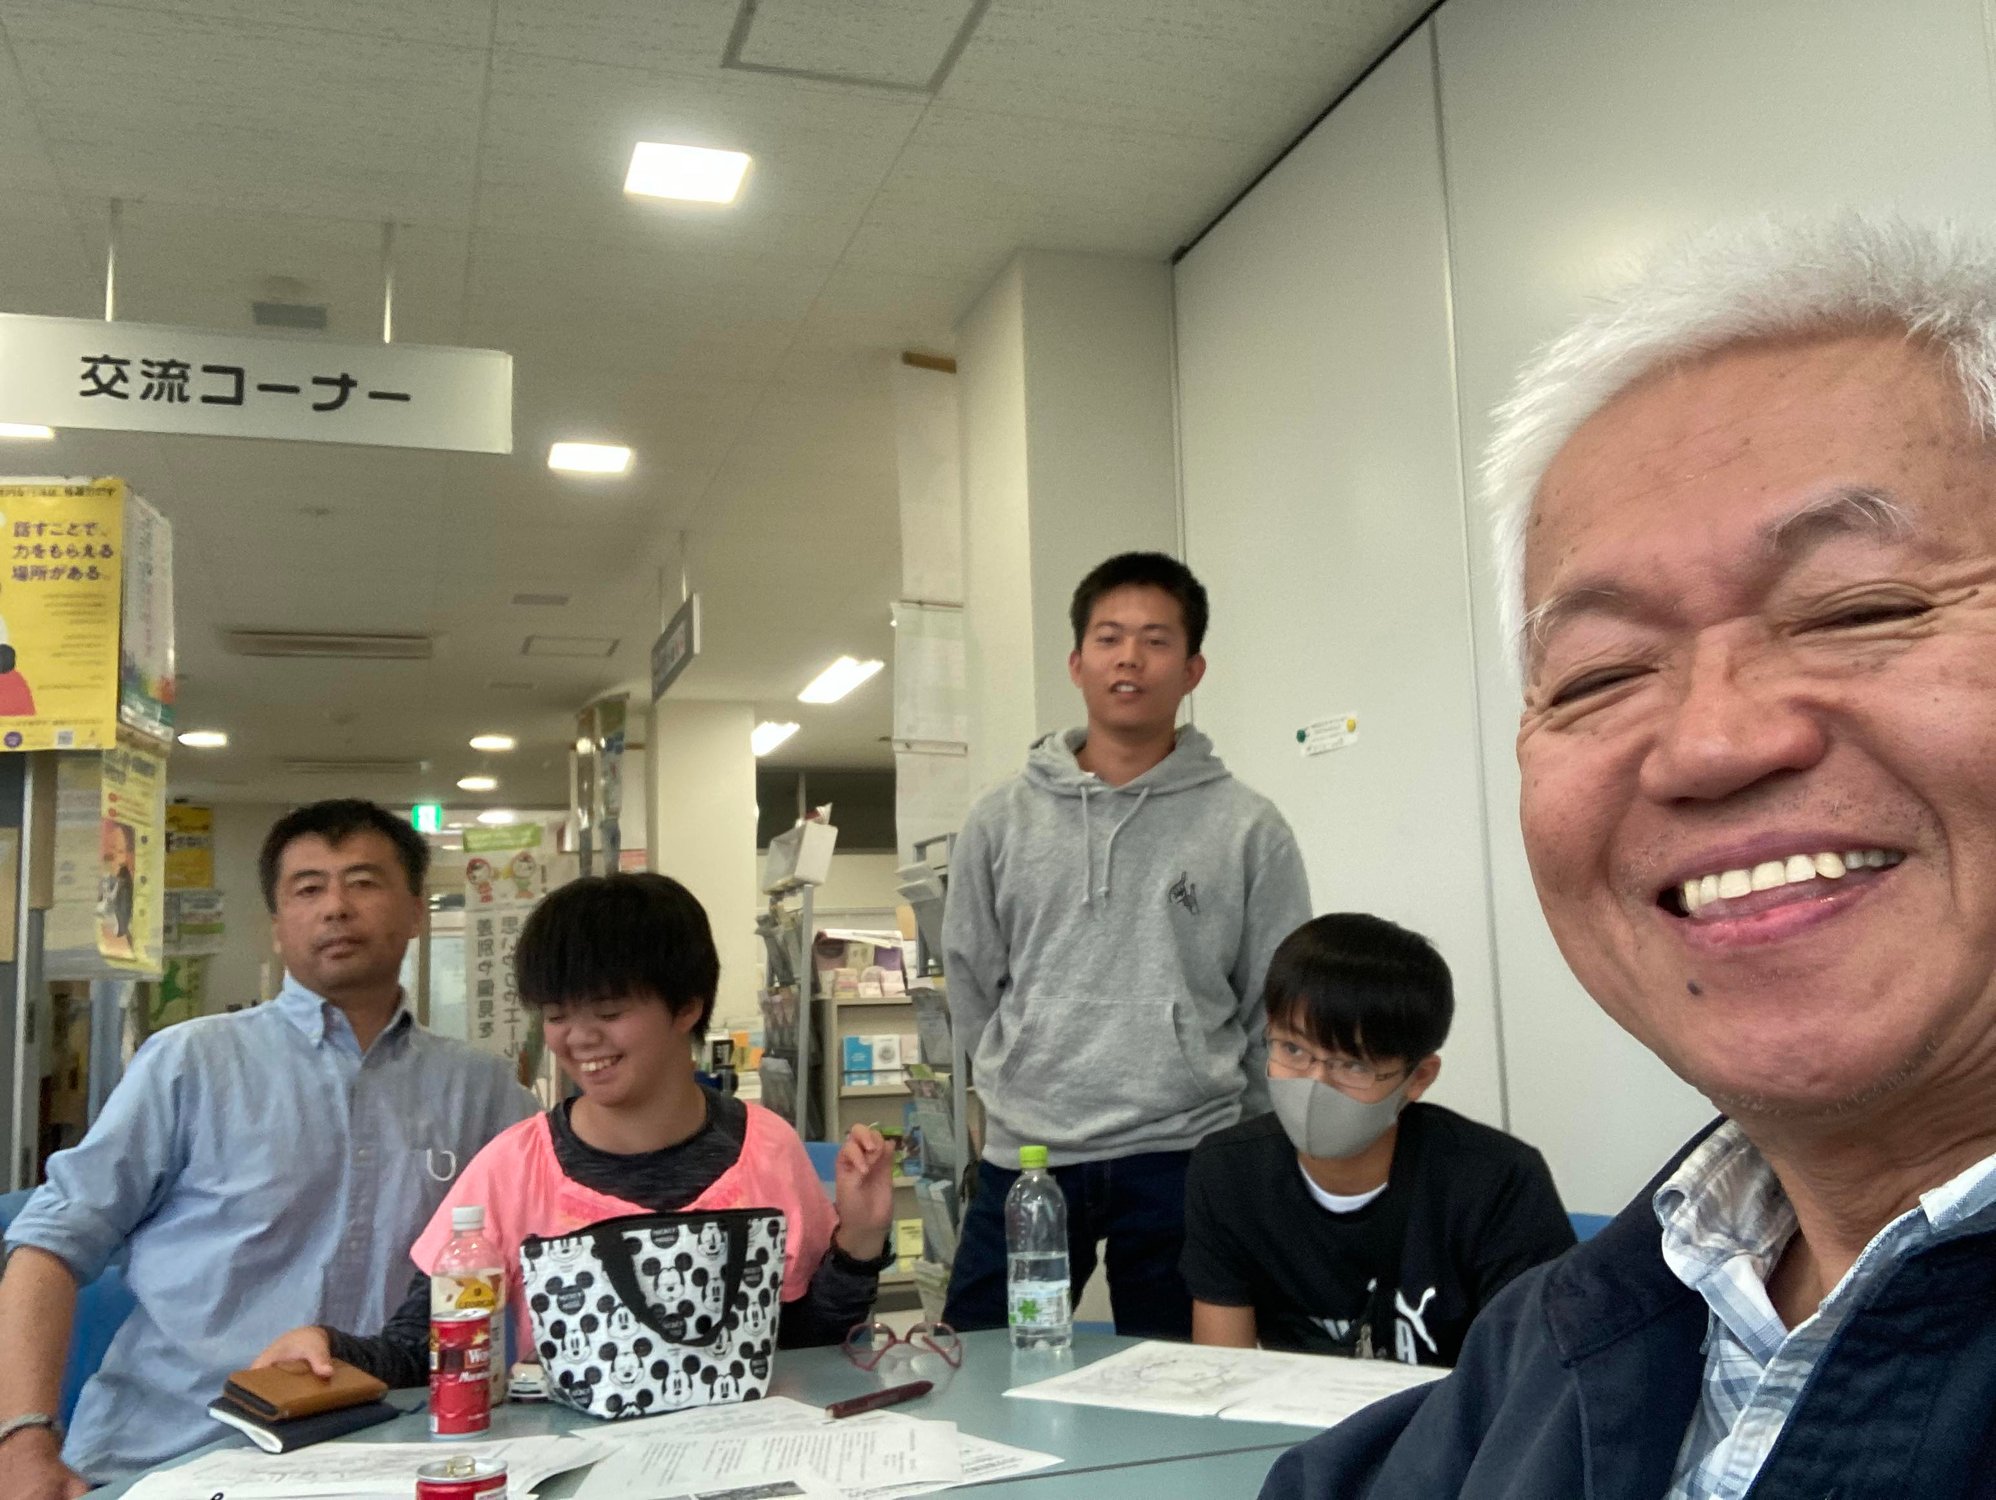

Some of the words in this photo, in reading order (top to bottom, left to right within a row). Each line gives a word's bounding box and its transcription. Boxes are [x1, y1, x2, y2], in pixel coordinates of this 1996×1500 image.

[79, 354, 412, 411] 交流コーナー
